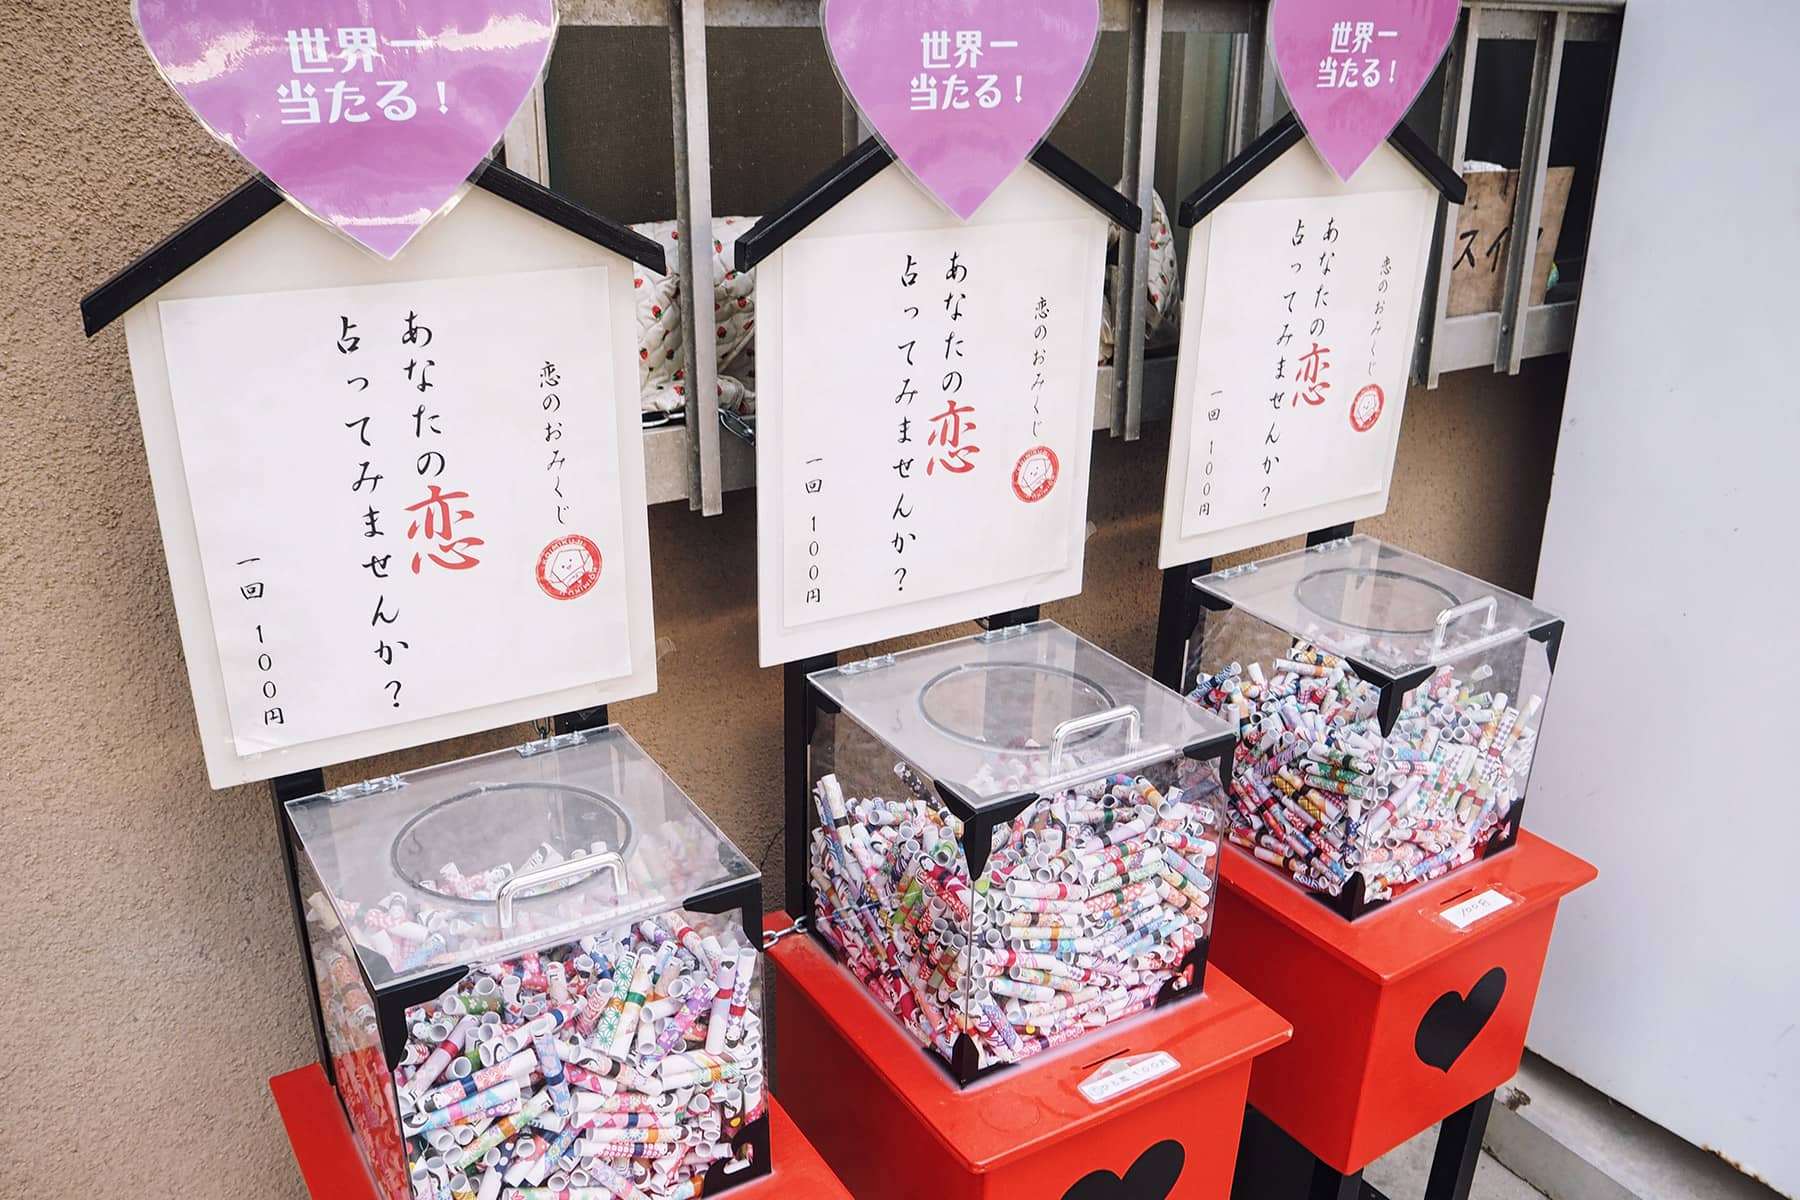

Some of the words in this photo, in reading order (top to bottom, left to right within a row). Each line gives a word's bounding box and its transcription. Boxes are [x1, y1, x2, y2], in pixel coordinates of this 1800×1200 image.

[284, 27, 434, 74] 世界一
[920, 30, 1018, 69] 世界一
[1330, 21, 1398, 53] 世界一
[910, 73, 1022, 111] 当たる！
[1317, 56, 1396, 88] 当たる！
[276, 79, 449, 124] 当たる！
[926, 250, 981, 477] あなたの恋
[401, 309, 485, 575] あなたの恋
